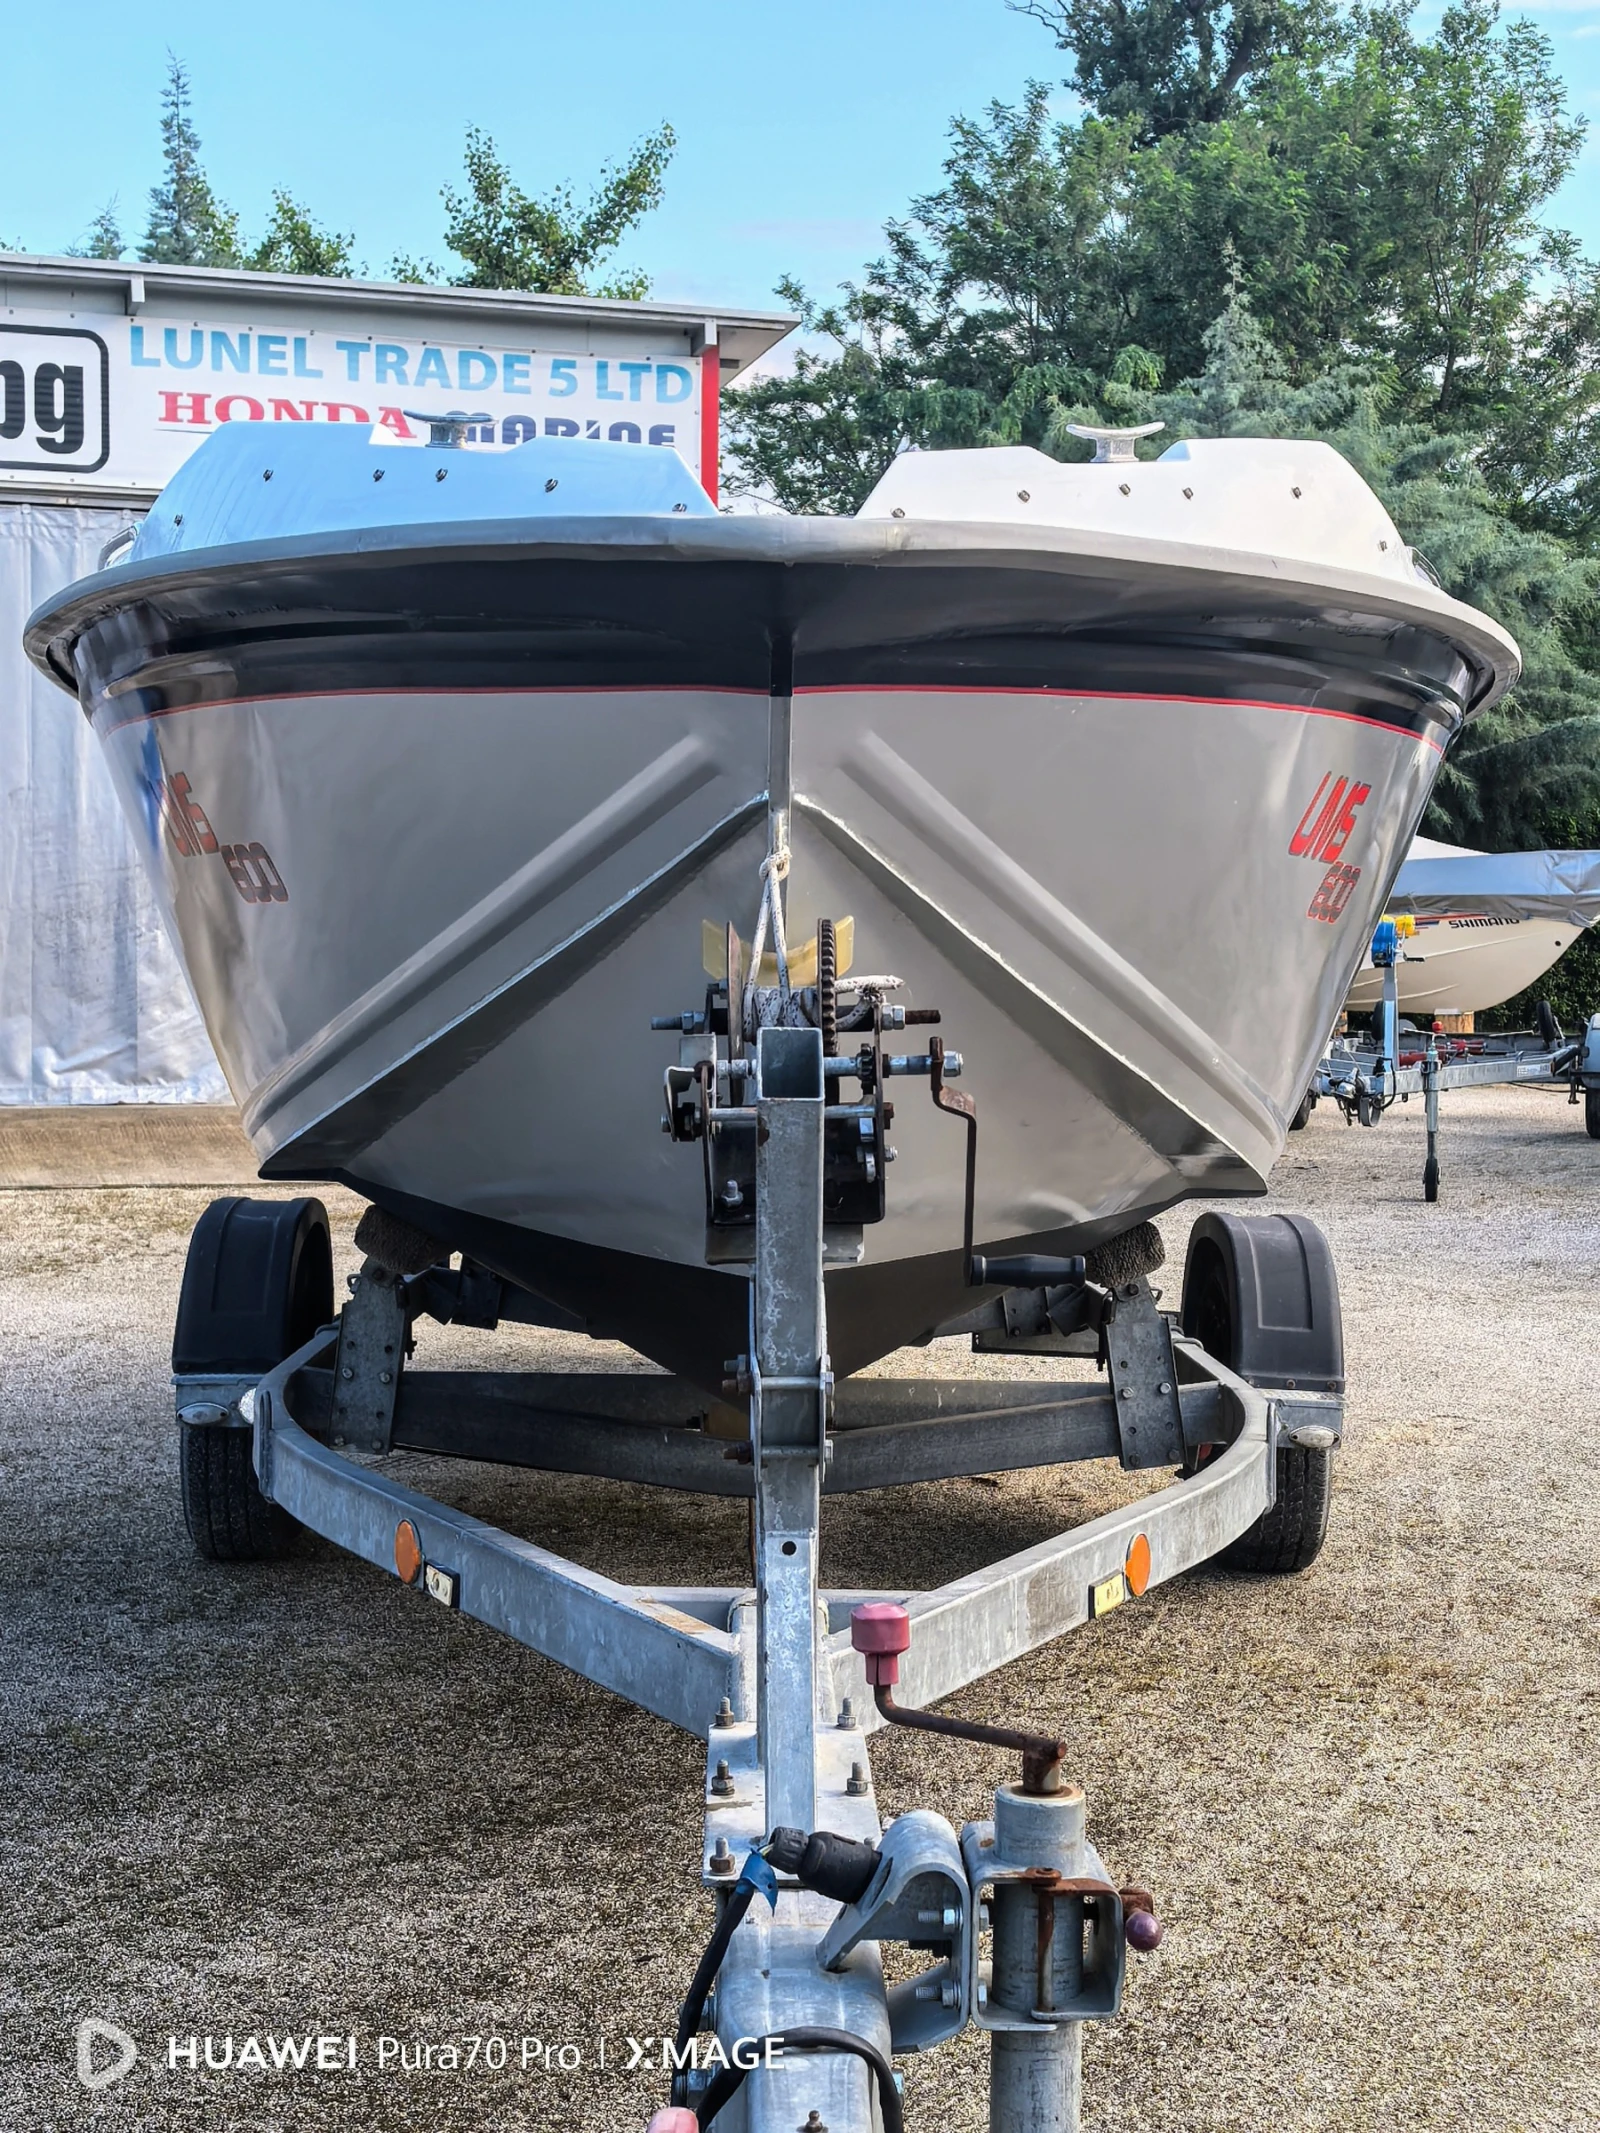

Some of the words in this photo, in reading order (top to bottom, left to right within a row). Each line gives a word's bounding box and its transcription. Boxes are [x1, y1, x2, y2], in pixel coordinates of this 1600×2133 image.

[131, 326, 323, 379] LUNEL
[336, 340, 531, 395] TRADE
[548, 358, 578, 397] 5
[596, 360, 693, 403] LTD
[158, 390, 417, 438] HONDA
[220, 842, 289, 904] 600
[1307, 860, 1361, 923] 600
